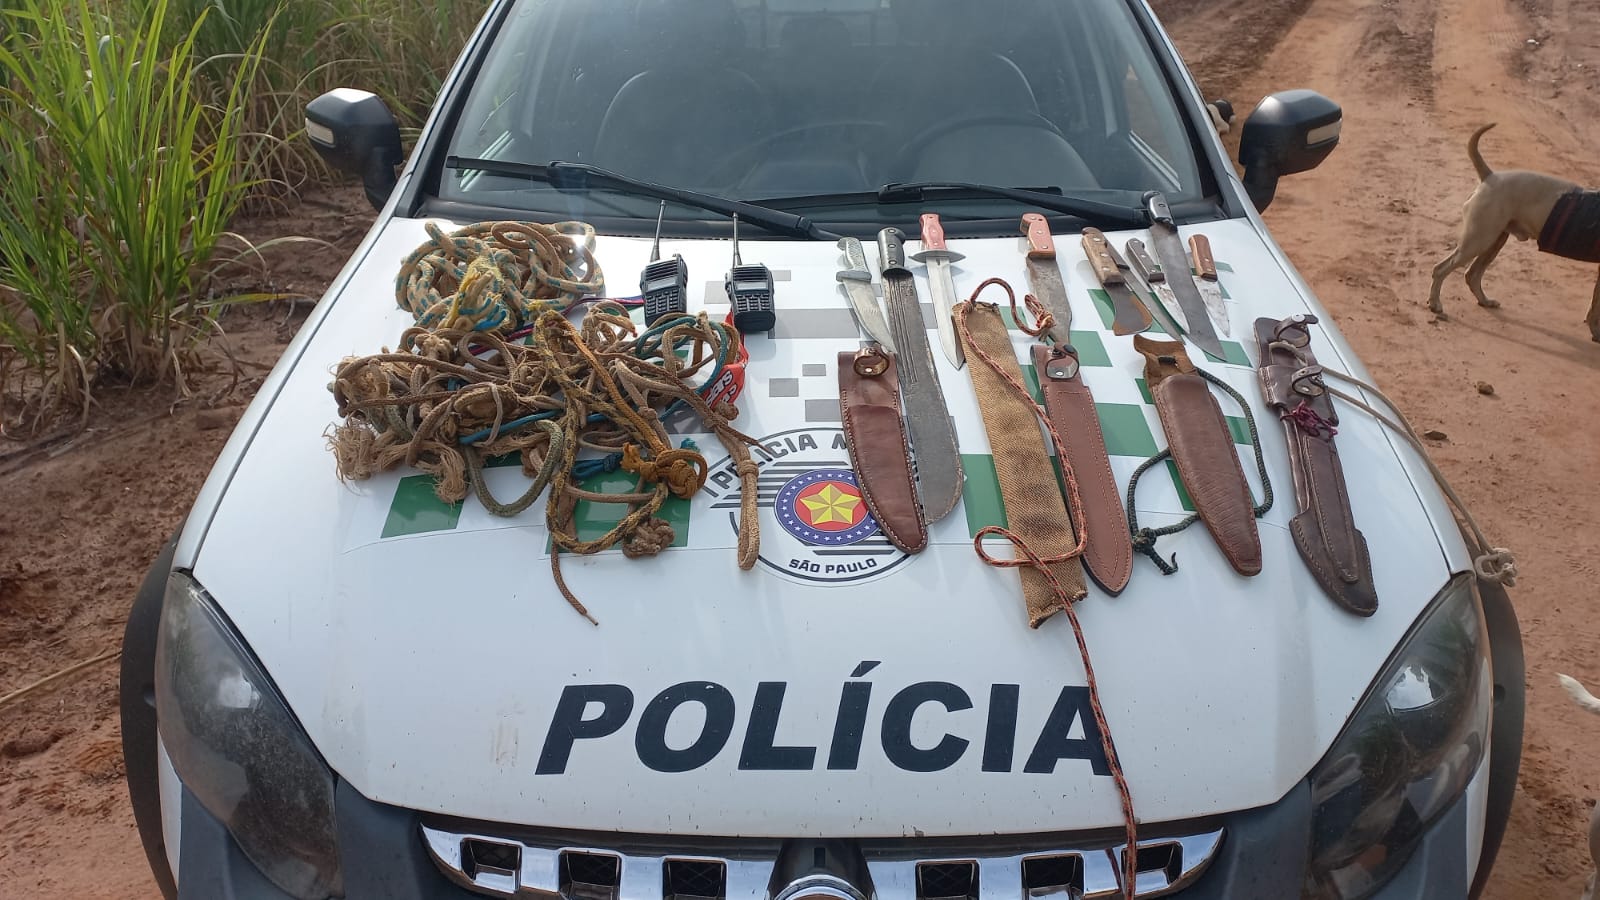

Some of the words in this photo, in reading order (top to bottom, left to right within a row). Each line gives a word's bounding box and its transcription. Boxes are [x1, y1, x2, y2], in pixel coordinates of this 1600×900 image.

[788, 558, 820, 573] SÃO
[825, 558, 878, 574] PAULO
[534, 660, 1124, 776] POLÍCIA
